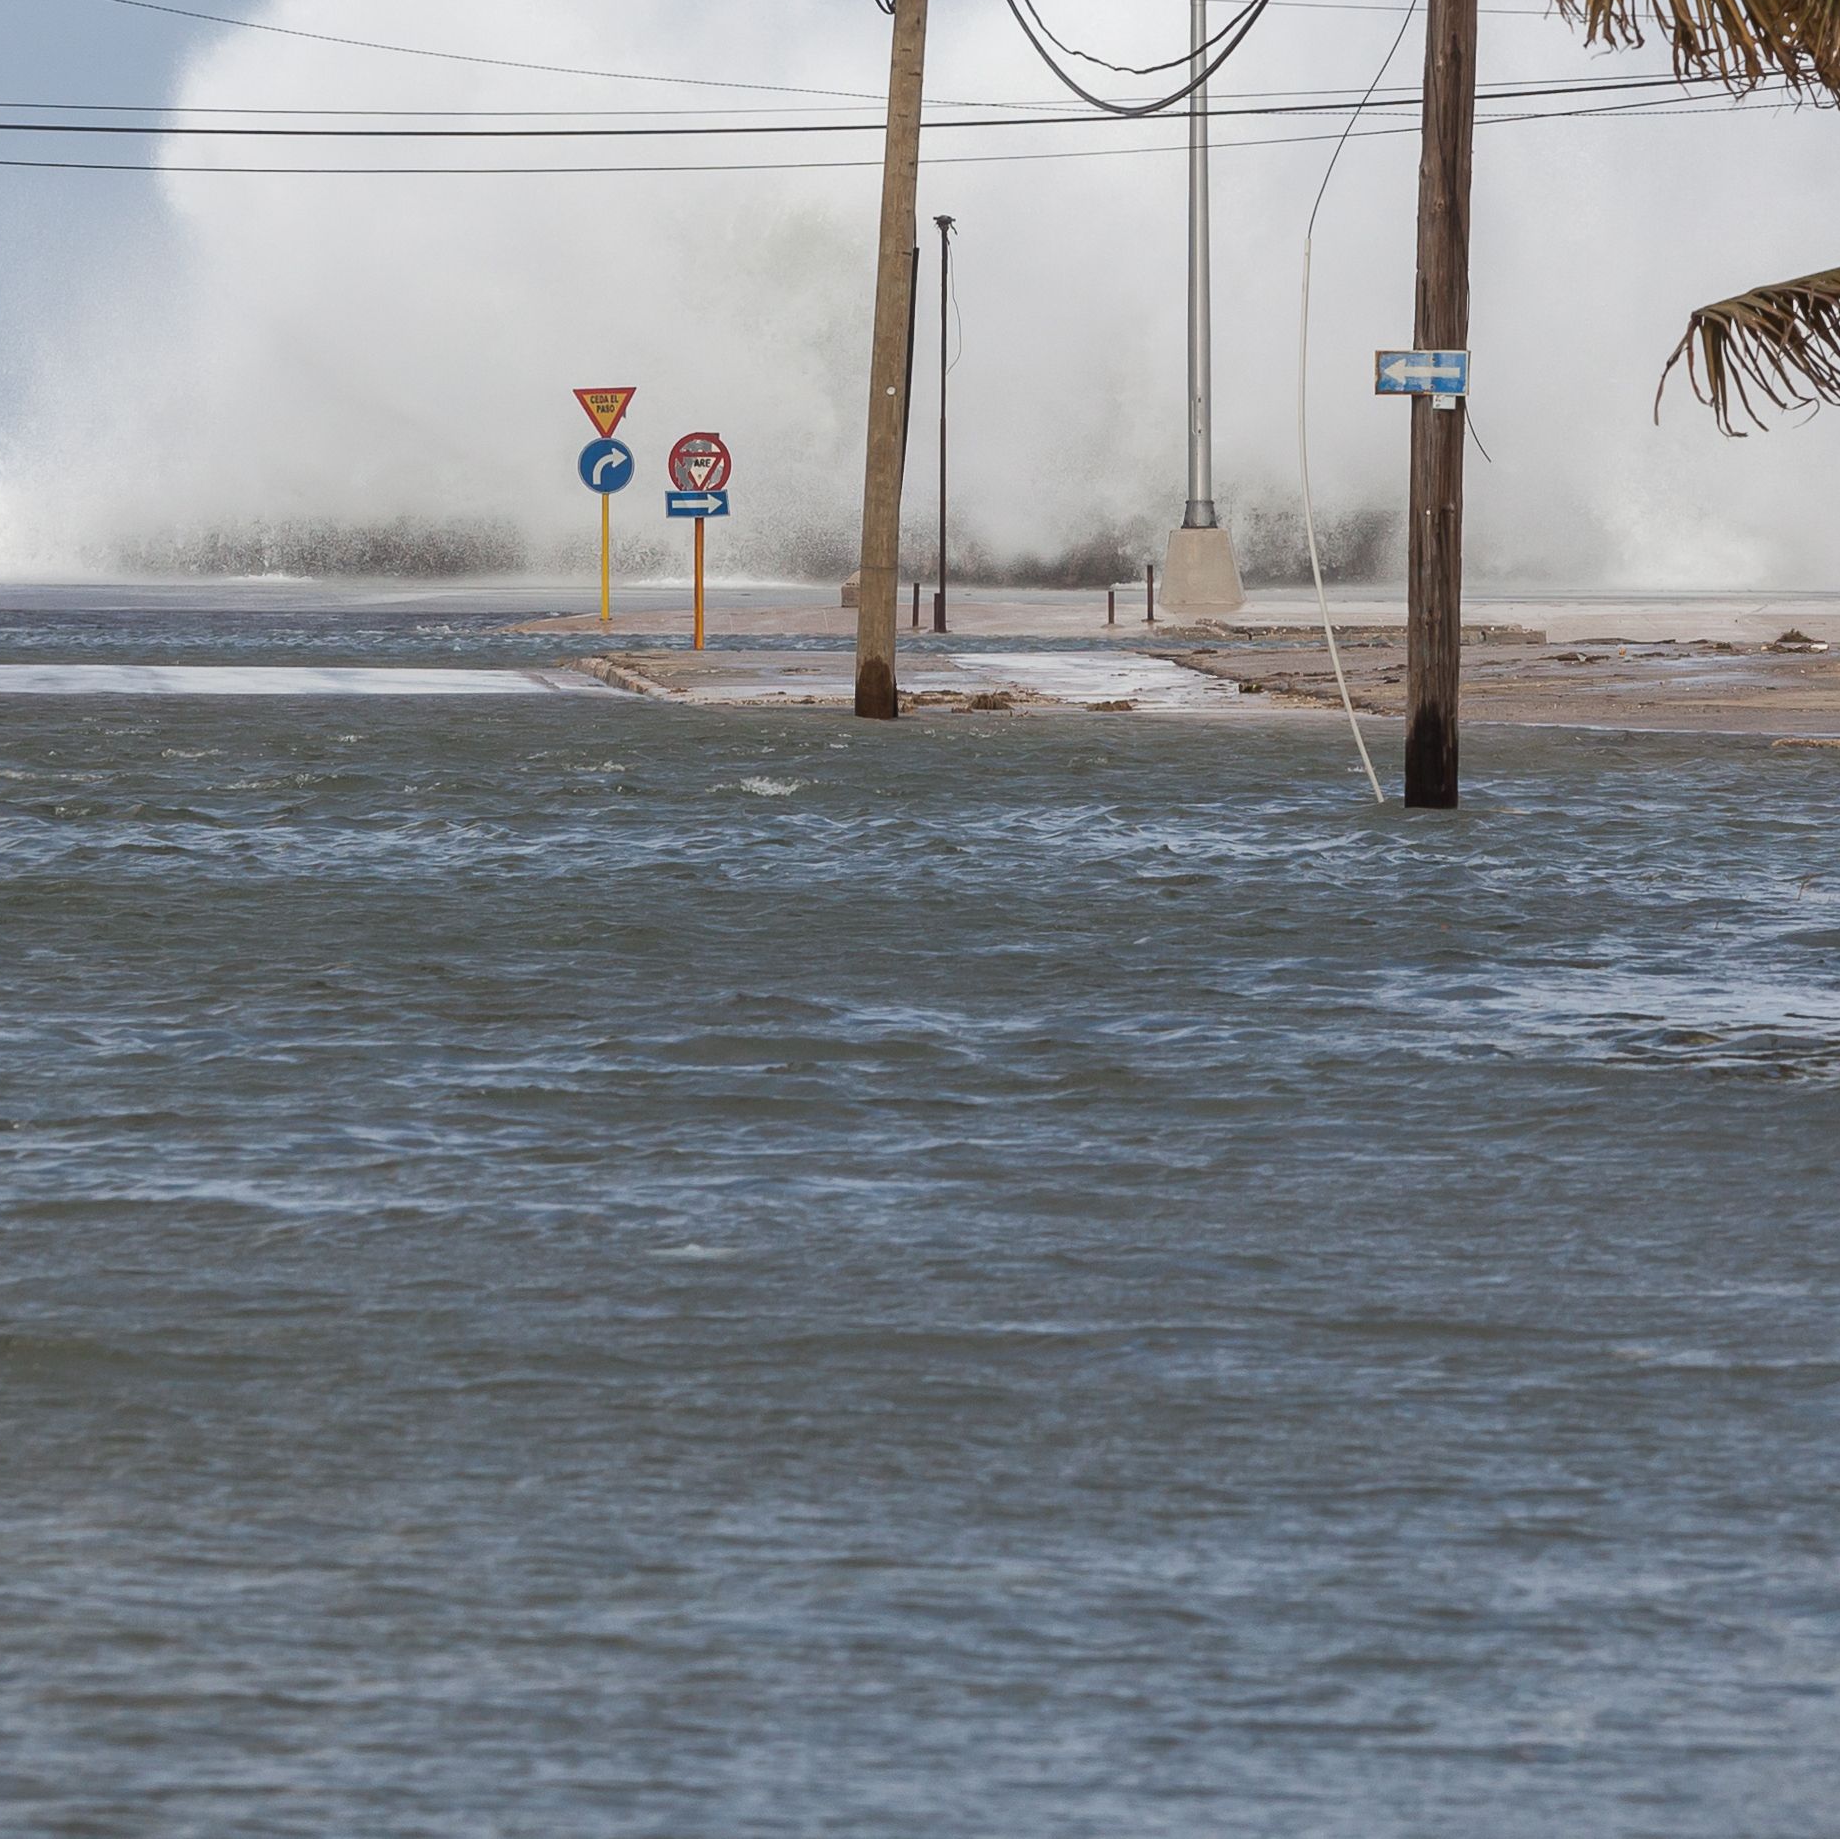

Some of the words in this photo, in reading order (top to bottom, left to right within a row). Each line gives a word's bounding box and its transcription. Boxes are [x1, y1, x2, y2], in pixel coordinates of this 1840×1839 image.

[590, 395, 609, 404] CEDA
[610, 395, 619, 403] EL
[596, 405, 615, 413] PASO
